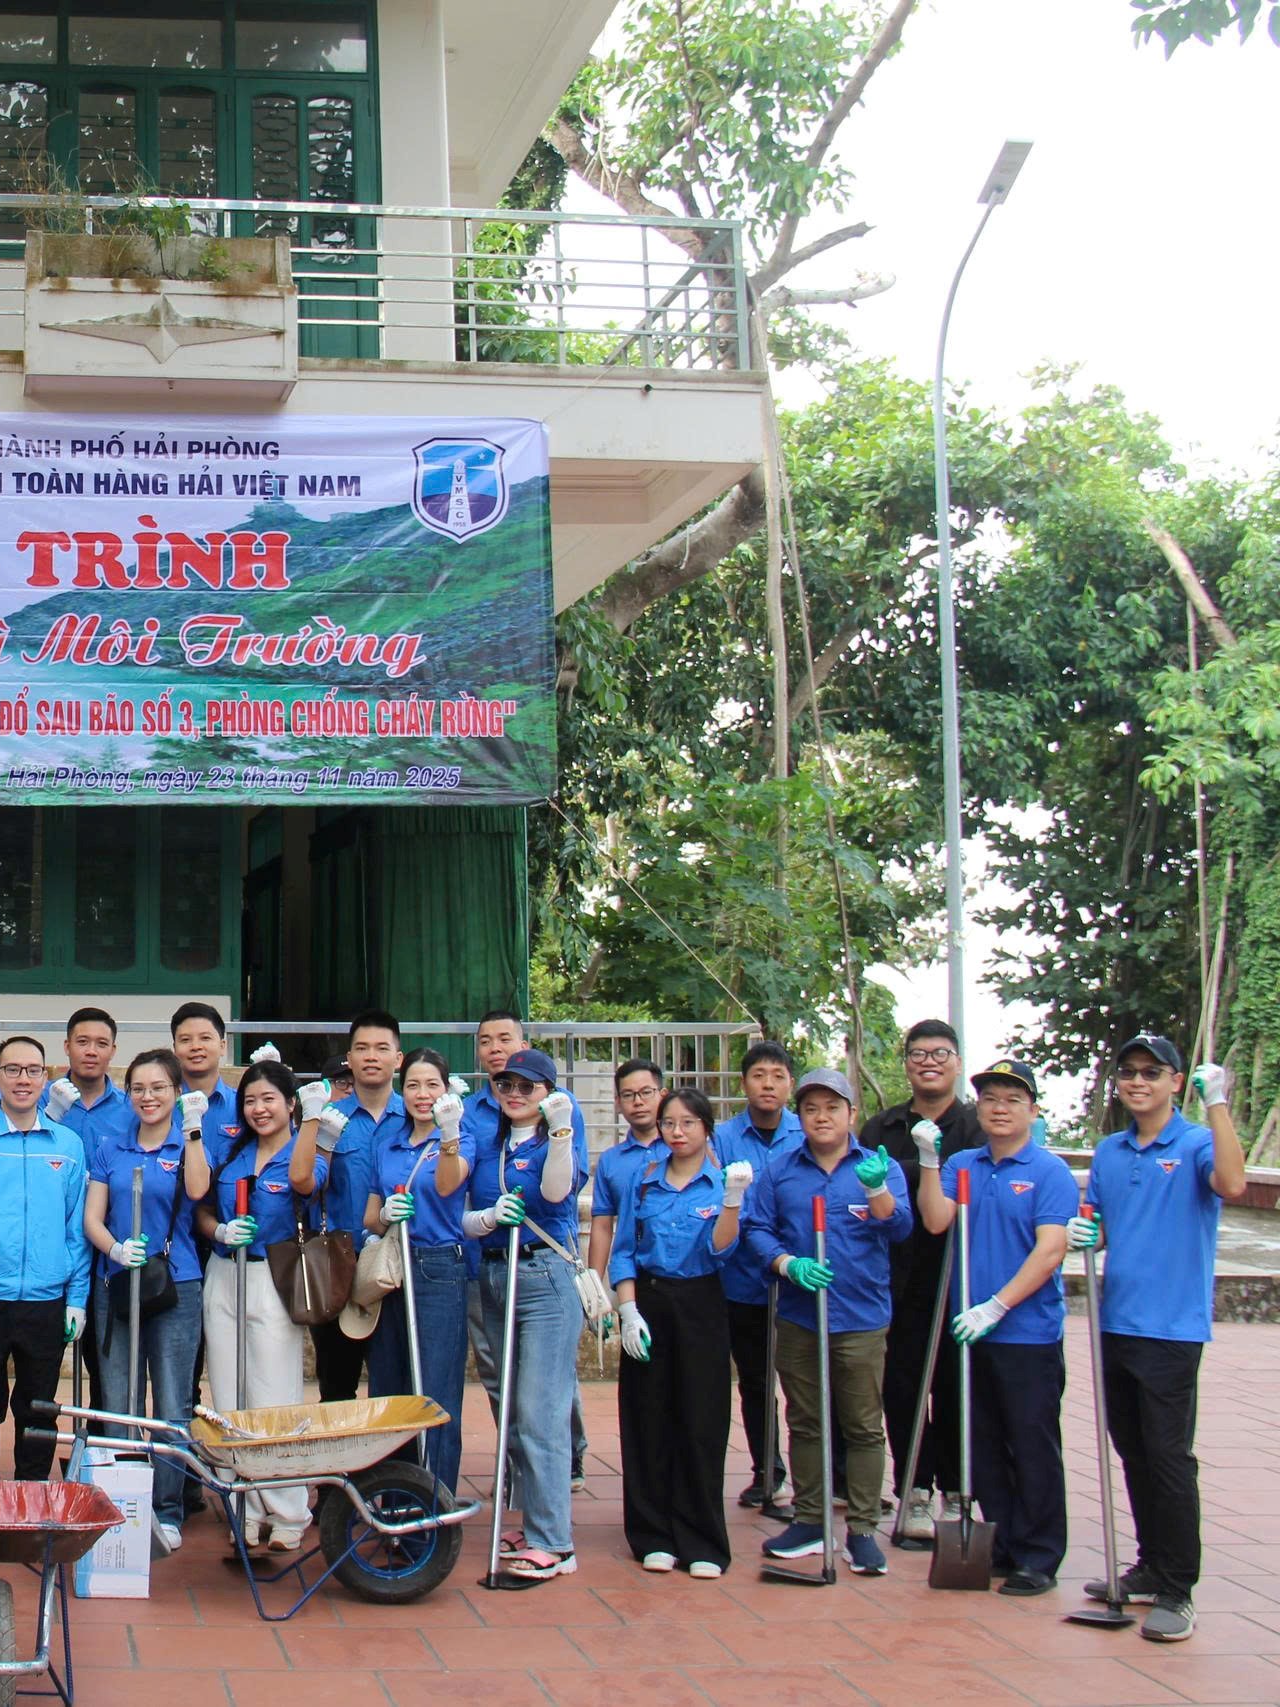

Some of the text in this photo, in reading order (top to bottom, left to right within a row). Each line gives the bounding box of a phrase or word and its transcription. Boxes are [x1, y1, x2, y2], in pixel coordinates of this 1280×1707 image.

[70, 431, 125, 460] PHỐ
[133, 432, 178, 460] HẢI
[187, 436, 280, 461] PHÒNG
[12, 468, 84, 495] TOÀN
[93, 468, 169, 496] HÀNG
[178, 465, 223, 496] HẢI
[232, 470, 289, 501] VIỆT
[298, 475, 361, 497] NAM
[16, 515, 291, 590] TRÌNH
[23, 613, 160, 666] Môi
[179, 613, 426, 677] Trường
[35, 700, 82, 736] SAU
[88, 693, 135, 736] BÃO
[141, 687, 171, 736] SỐ
[178, 700, 201, 741] 3,
[206, 691, 285, 737] PHÒNG
[290, 687, 370, 737] CHỐNG
[375, 692, 436, 737] CHÁY
[440, 691, 517, 737] RỪNG"
[7, 766, 461, 793] Hải Phòng, ngày 23 tháng 11 năm 2025
